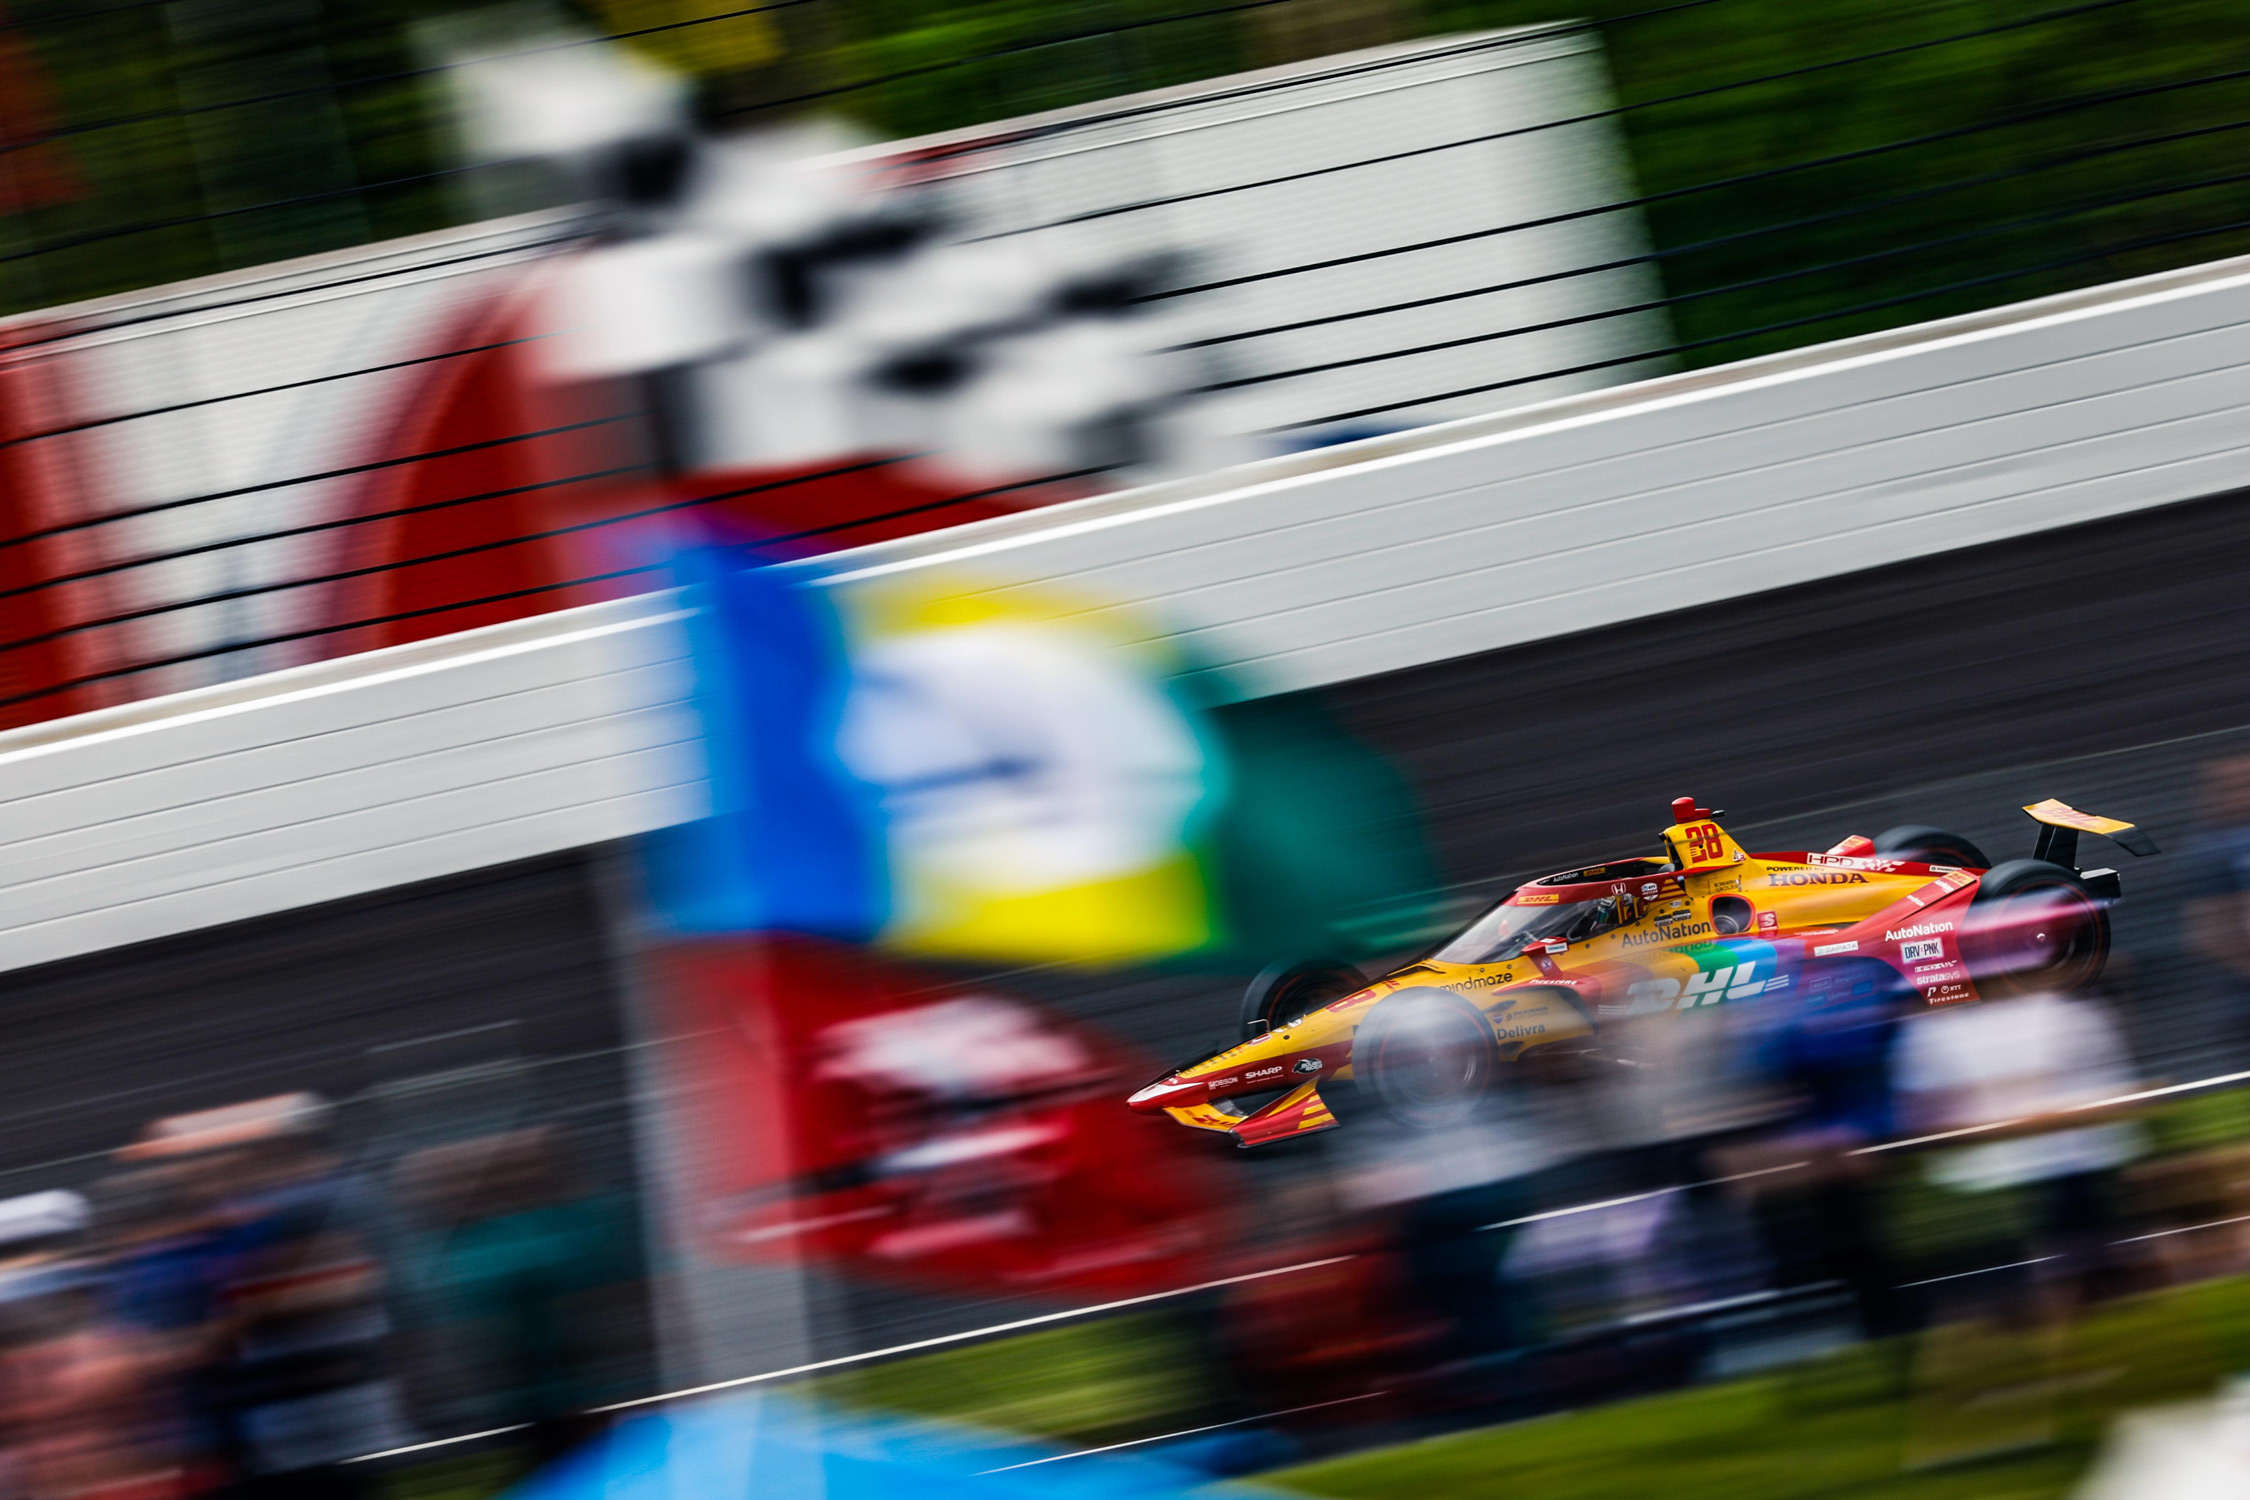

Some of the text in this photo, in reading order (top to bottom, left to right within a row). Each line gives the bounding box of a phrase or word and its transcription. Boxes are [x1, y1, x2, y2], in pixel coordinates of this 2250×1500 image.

[1685, 823, 1723, 863] 28
[1808, 854, 1854, 867] HPD
[1768, 872, 1870, 887] HONDA
[1621, 920, 1712, 949] AutoNation
[1884, 921, 1954, 942] AutoNation
[1904, 942, 1940, 959] DRV PNK
[1916, 970, 1961, 985] stratasys
[1624, 961, 1767, 1015] DHL
[1929, 992, 1970, 1005] Firestone
[1497, 1024, 1546, 1040] Delivra
[1245, 1065, 1283, 1080] SHARP
